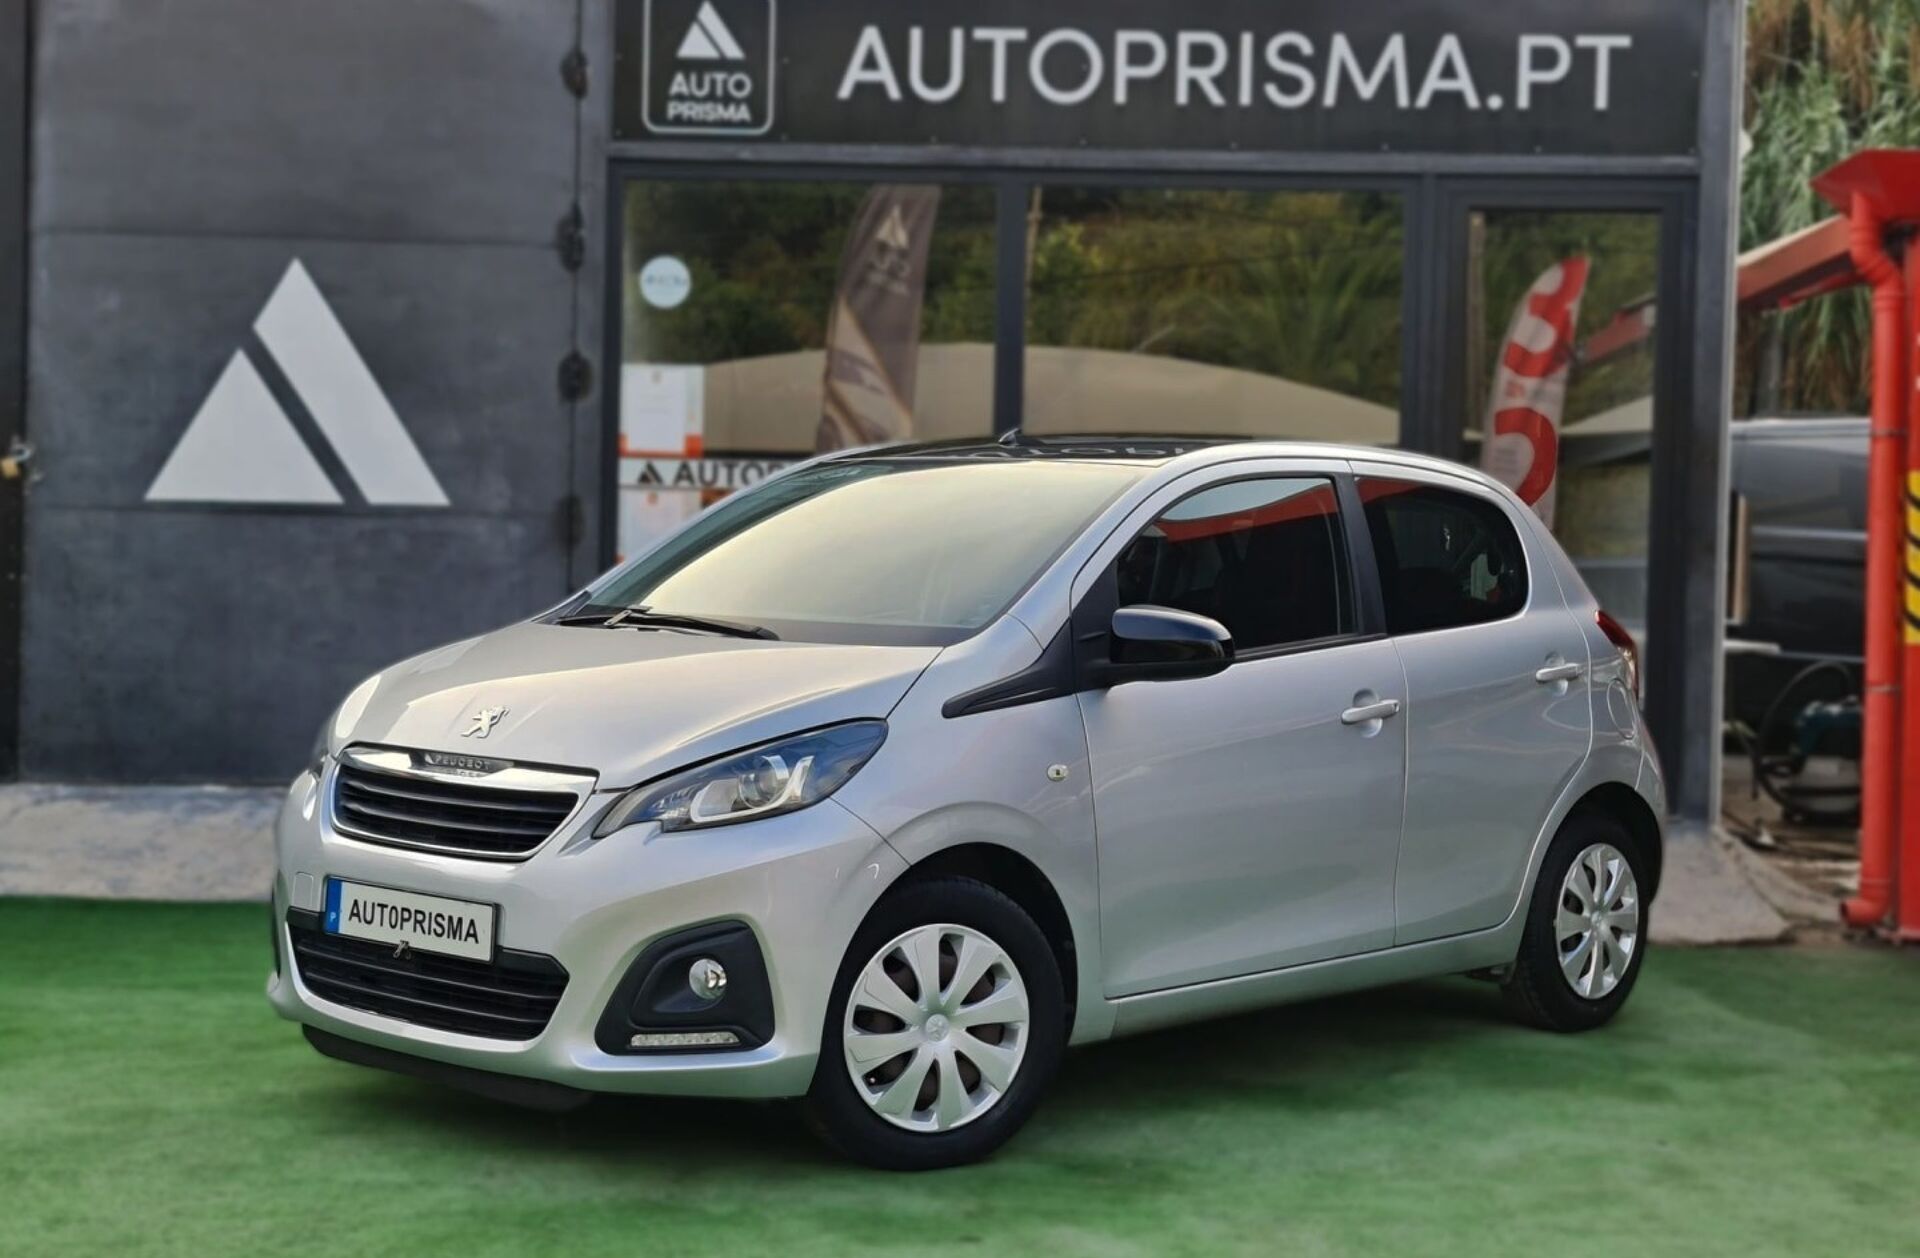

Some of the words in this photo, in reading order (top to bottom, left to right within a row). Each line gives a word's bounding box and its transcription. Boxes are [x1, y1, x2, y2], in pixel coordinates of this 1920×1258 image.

[837, 25, 1632, 111] AUTOPRISMA.PT
[668, 72, 752, 99] AUTO
[666, 102, 751, 123] PRISMA
[433, 755, 490, 770] PEUGEOT
